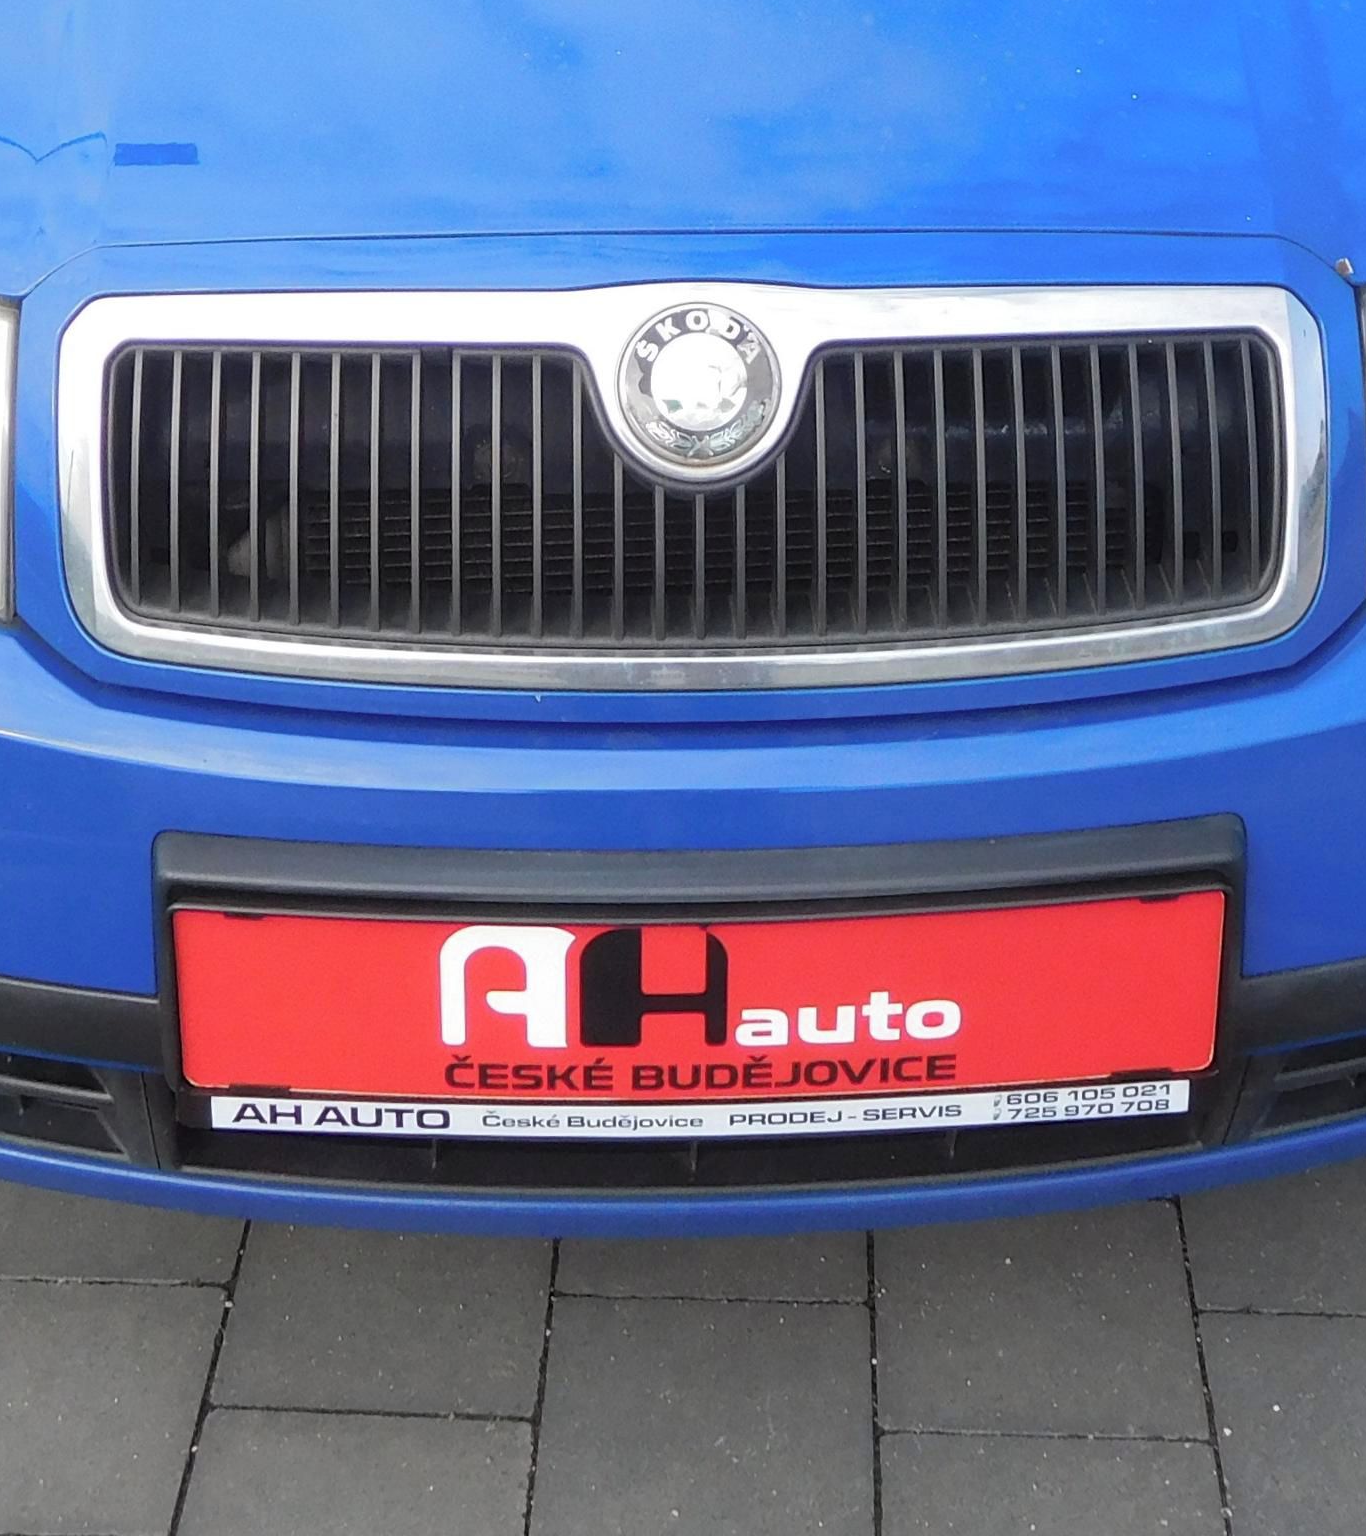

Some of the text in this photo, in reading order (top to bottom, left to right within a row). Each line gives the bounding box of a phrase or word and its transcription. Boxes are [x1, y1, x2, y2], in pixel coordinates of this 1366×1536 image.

[444, 1053, 957, 1091] ČESKÉ BUDĚJOVICE
[1006, 1083, 1171, 1106] 606 105 021
[232, 1102, 303, 1126] AH
[314, 1106, 451, 1130] AUTO
[481, 1110, 560, 1129] České
[566, 1113, 704, 1131] Budějovice
[729, 1110, 843, 1126] PRODEJ
[862, 1104, 962, 1122] SERVIS
[1007, 1098, 1170, 1120] 725 970 708
